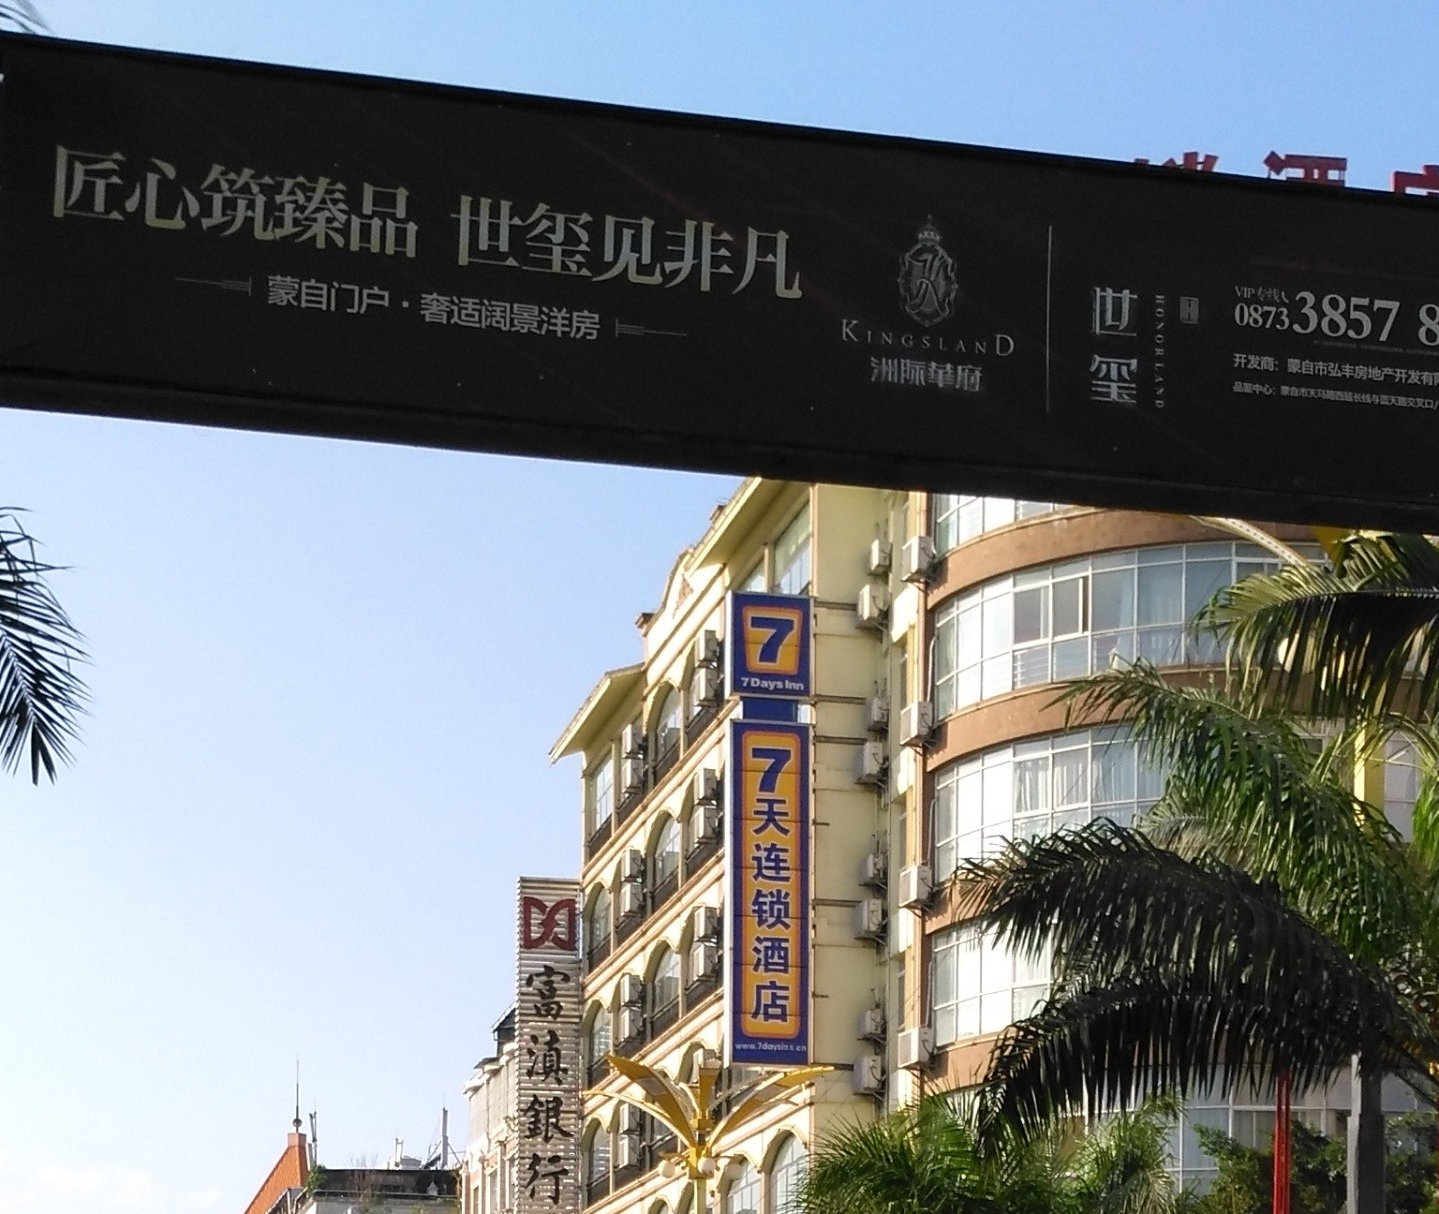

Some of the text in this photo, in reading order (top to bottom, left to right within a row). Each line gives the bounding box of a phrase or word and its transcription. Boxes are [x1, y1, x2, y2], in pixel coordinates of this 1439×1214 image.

[53, 146, 803, 300] 匠心筑臻品 世玺见非凡
[840, 318, 1016, 357] KINGSLAND
[1234, 302, 1290, 330] 0873
[1292, 291, 1400, 342] 3857
[1089, 287, 1138, 404] 世玺
[750, 615, 795, 663] 7
[785, 680, 805, 691] Inn
[750, 747, 792, 1024] 7天连锁酒店
